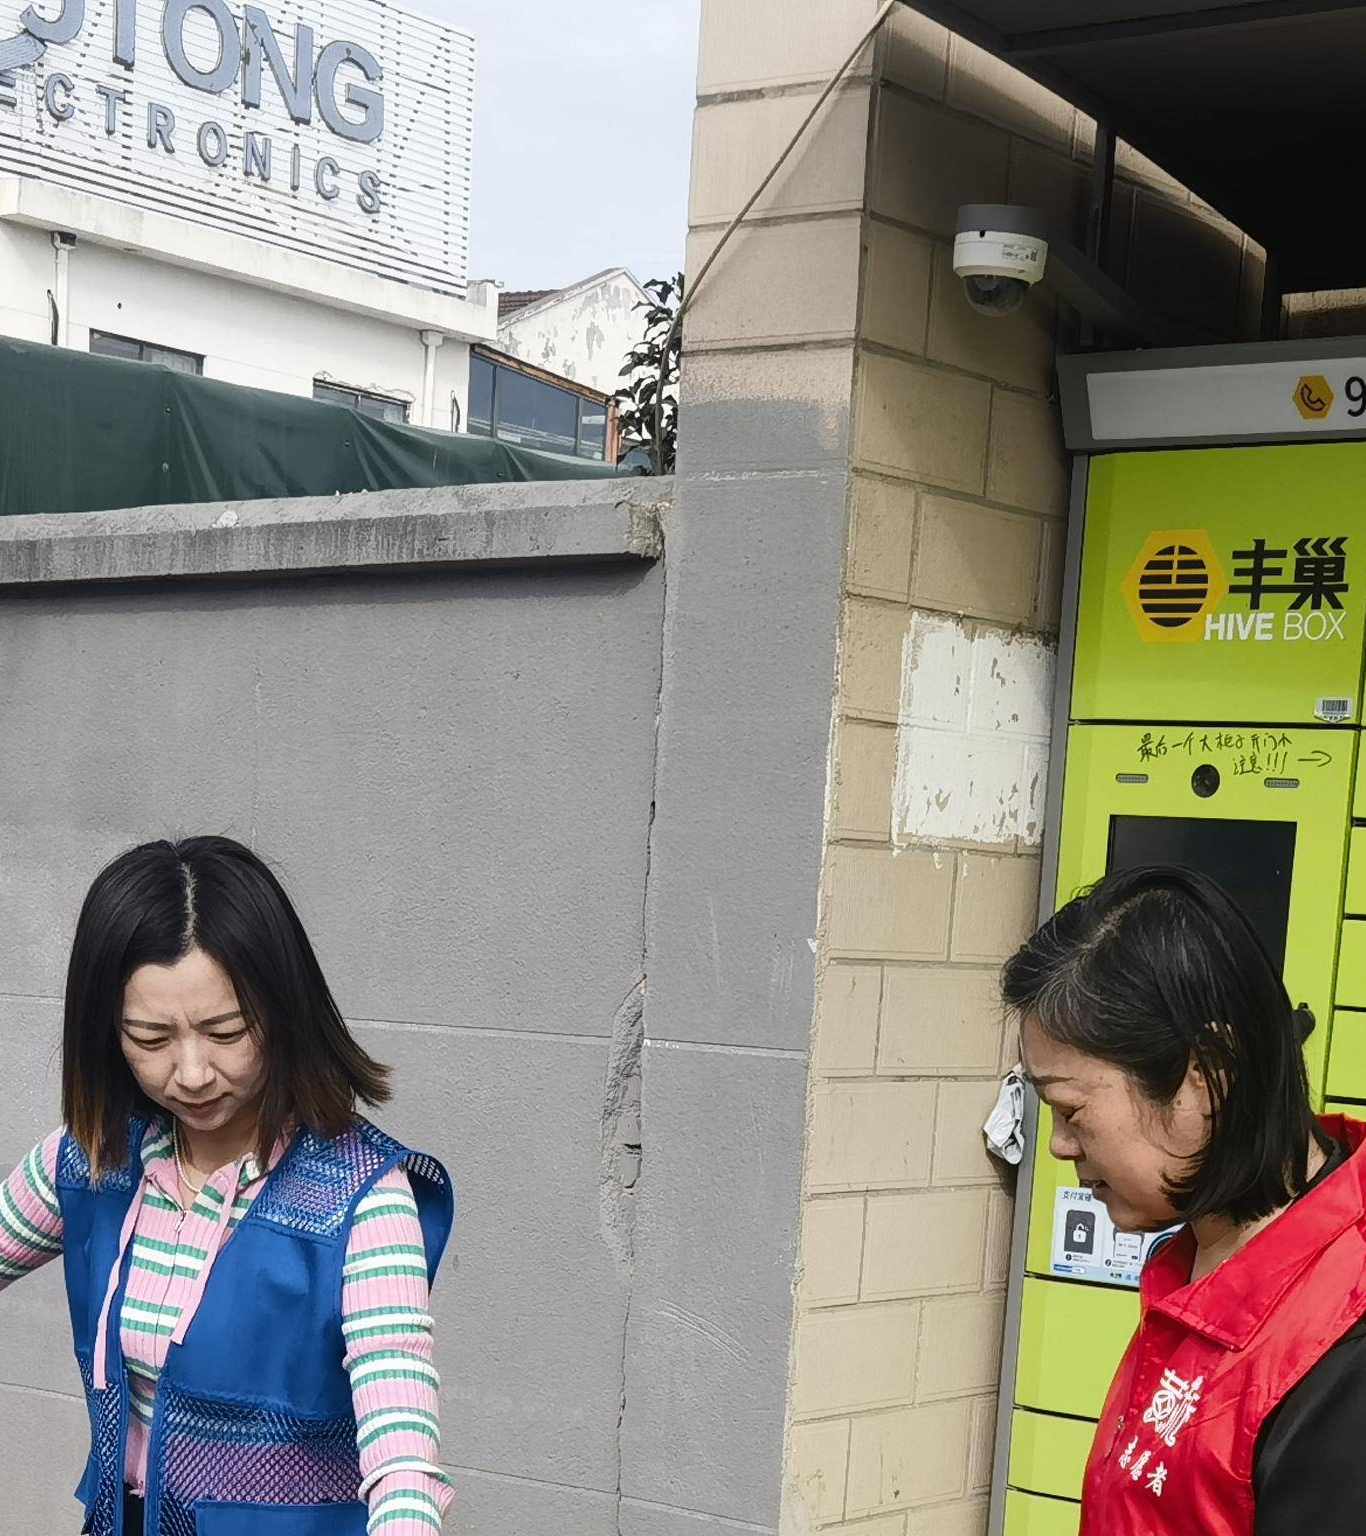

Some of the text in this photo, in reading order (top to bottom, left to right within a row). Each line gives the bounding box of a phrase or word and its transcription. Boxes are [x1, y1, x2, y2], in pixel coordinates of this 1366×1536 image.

[1228, 536, 1350, 611] 丰巢
[1203, 611, 1346, 641] HIVE BOX
